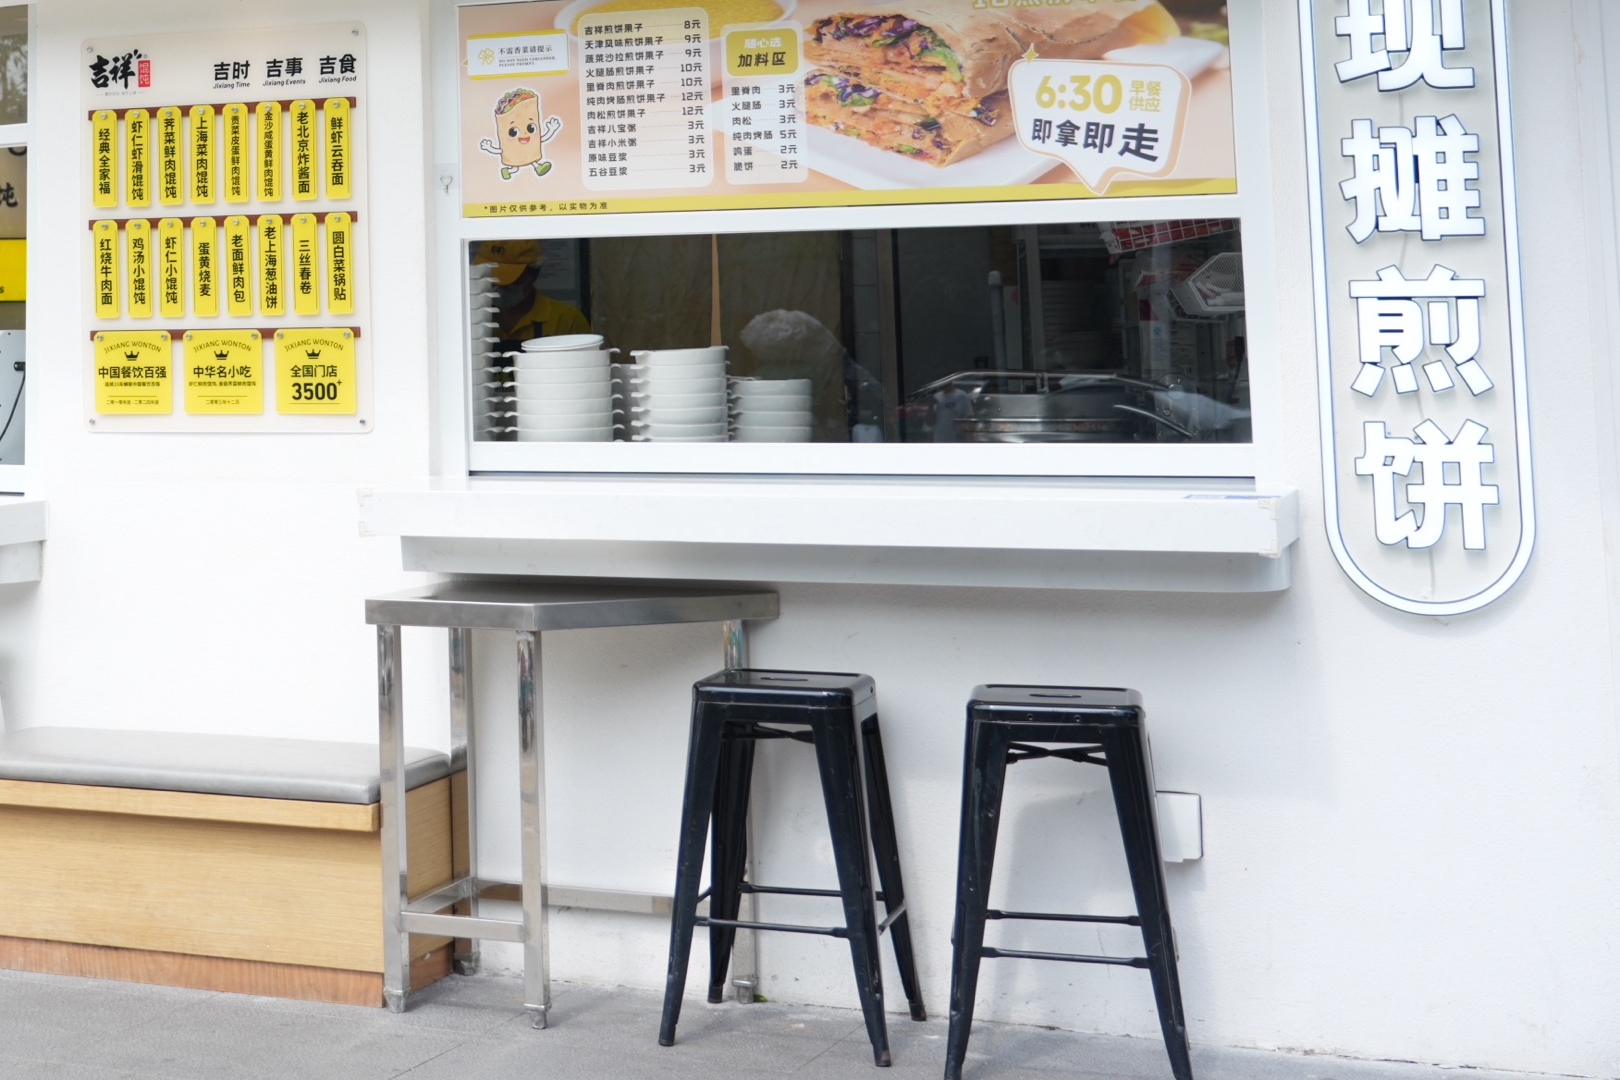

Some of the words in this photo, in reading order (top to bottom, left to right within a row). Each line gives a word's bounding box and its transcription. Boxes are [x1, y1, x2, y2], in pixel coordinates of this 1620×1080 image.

[584, 23, 643, 35] 吉祥煎饼果子
[684, 20, 701, 30] 8元
[585, 37, 664, 50] 天津风味煎饼果子
[685, 34, 701, 44] 9元
[319, 53, 357, 75] 吉食
[585, 51, 664, 64] 蔬菜沙拉煎饼果子
[685, 49, 702, 58] 9元
[737, 52, 787, 67] 加料区
[89, 49, 142, 89] 吉祥
[213, 60, 250, 81] 吉时
[266, 57, 303, 78] 吉事
[586, 65, 655, 78] 火腿肠煎饼果子
[680, 63, 702, 73] 10元
[213, 81, 235, 89] Jixiang
[263, 79, 284, 87] Jixiang
[586, 79, 655, 92] 里脊肉煎饼果子
[681, 77, 703, 87] 10元
[731, 86, 761, 96] 里脊肉
[778, 84, 795, 93] 3元
[1129, 80, 1162, 96] 早餐
[681, 92, 704, 101] 12元
[1035, 74, 1123, 114] 6:30
[779, 100, 796, 109] 3元
[1129, 96, 1162, 113] 供应
[587, 108, 646, 120] 肉松煎饼果子
[682, 106, 704, 116] 12元
[732, 117, 752, 126] 肉松
[779, 115, 796, 124] 3元
[587, 123, 637, 135] 吉祥八宝粥
[688, 121, 704, 130] 3元
[780, 130, 797, 139] 5元
[588, 138, 637, 149] 吉祥小米粥
[688, 135, 705, 145] 3元
[1031, 118, 1159, 162] 即拿即走
[164, 118, 177, 198] 荠菜鲜肉馄饨
[196, 117, 208, 198] 上海菜肉馄饨
[297, 111, 310, 193] 老北京炸酱面
[330, 117, 344, 186] 鲜虾云吞面
[588, 152, 627, 163] 原味豆浆
[688, 149, 705, 159] 3元
[733, 147, 753, 156] 鸡蛋
[780, 145, 797, 154] 2元
[98, 128, 110, 195] 经典全家福
[131, 121, 144, 201] 虾仁虾滑馄饨
[781, 160, 798, 169] 2元
[589, 167, 628, 177] 五谷豆浆
[689, 164, 706, 173] 3元
[100, 239, 113, 305] 红烧牛肉面
[132, 238, 146, 304] 鸡汤小馄饨
[165, 237, 178, 304] 虾仁小馄饨
[198, 242, 211, 297] 蛋黄烧麦
[231, 234, 245, 303] 老面鲜肉包
[264, 227, 278, 309] 老上海葱油饼
[299, 240, 312, 294] 三丝春卷
[332, 231, 346, 301] 圆白菜锅贴
[104, 341, 130, 354] JIXIANG
[131, 341, 161, 352] WONTON
[193, 340, 219, 353] JIXIANG
[221, 340, 252, 351] WONTON
[284, 339, 311, 352] JIXIANG
[313, 339, 344, 351] WONTON
[99, 366, 167, 378] 中国餐饮百强
[194, 366, 252, 378] 中华名小吃
[290, 365, 337, 377] 全国门店
